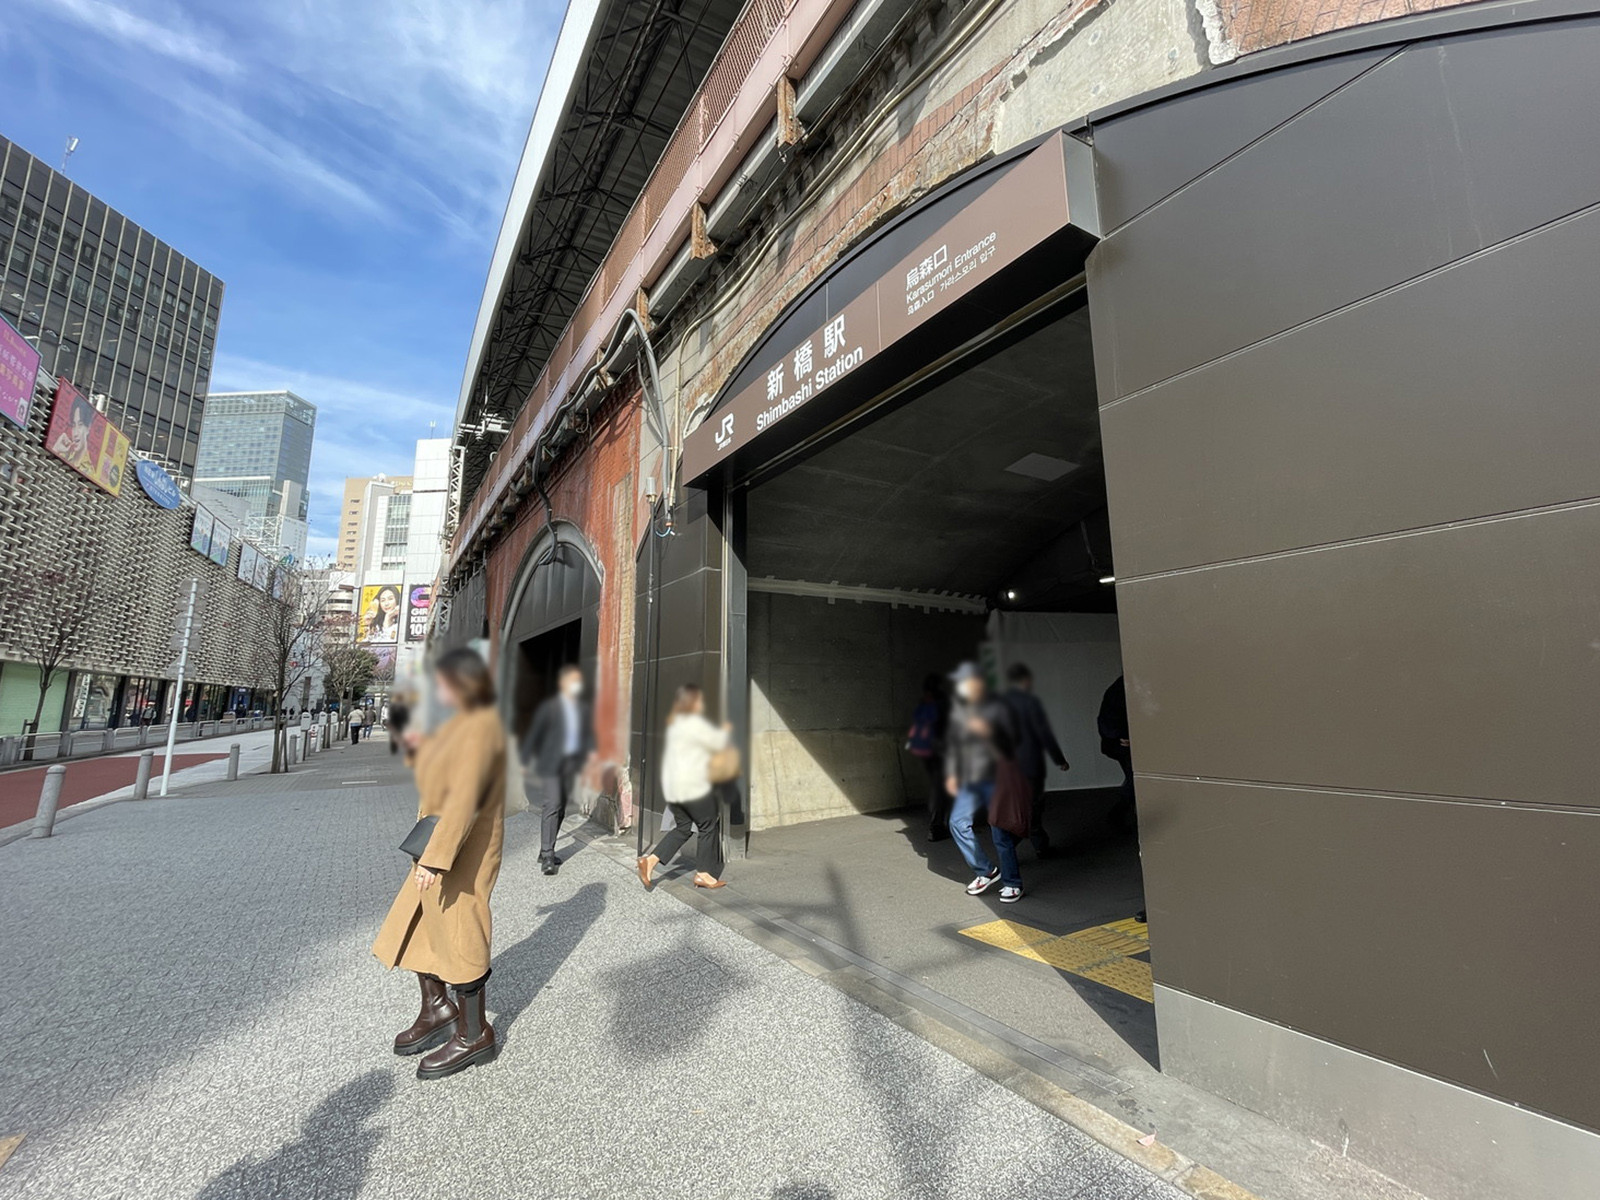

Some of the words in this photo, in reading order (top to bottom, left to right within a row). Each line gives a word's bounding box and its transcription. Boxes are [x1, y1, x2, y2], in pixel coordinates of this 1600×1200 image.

[906, 262, 953, 304] Karasumori
[954, 232, 997, 269] Entrance
[756, 378, 813, 431] Shimbashi
[815, 346, 863, 390] Station
[766, 314, 846, 401] 新橋駅
[715, 412, 734, 444] JR
